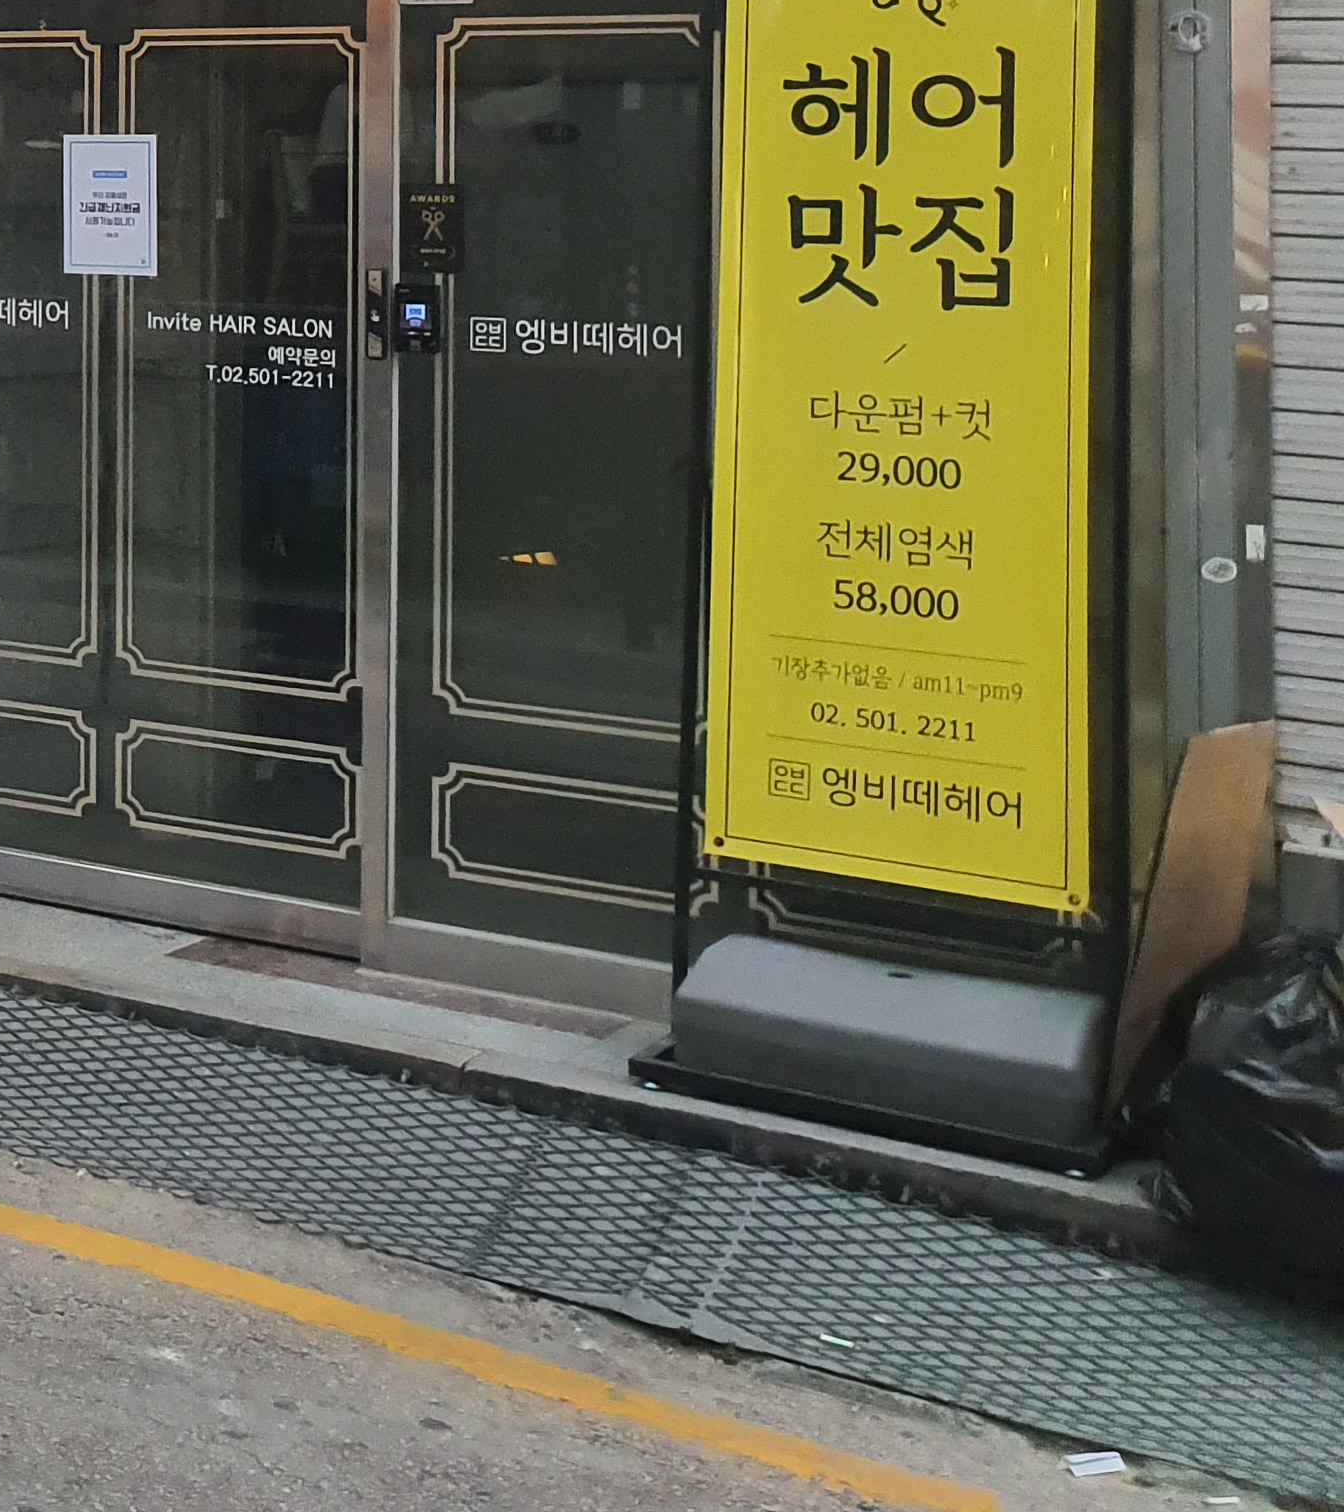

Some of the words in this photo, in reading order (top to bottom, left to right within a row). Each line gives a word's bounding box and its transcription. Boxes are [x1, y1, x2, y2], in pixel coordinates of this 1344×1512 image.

[782, 45, 1016, 169] 헤어
[409, 195, 456, 204] AWARDS
[787, 183, 1015, 311] 맛집
[146, 310, 203, 333] Invite
[210, 313, 256, 336] HAIR
[263, 316, 334, 340] SALON
[515, 319, 683, 359] 엥비떼헤어
[205, 363, 336, 390] T.02.501-2211
[267, 346, 338, 369] 예약문의
[809, 389, 993, 443] 다운펌+컷
[836, 450, 962, 491] 29,000
[816, 519, 975, 572] 전체염색
[833, 578, 960, 621] 58,000
[771, 654, 892, 691] 기장추가없음
[821, 765, 1024, 831] 엥비떼헤어
